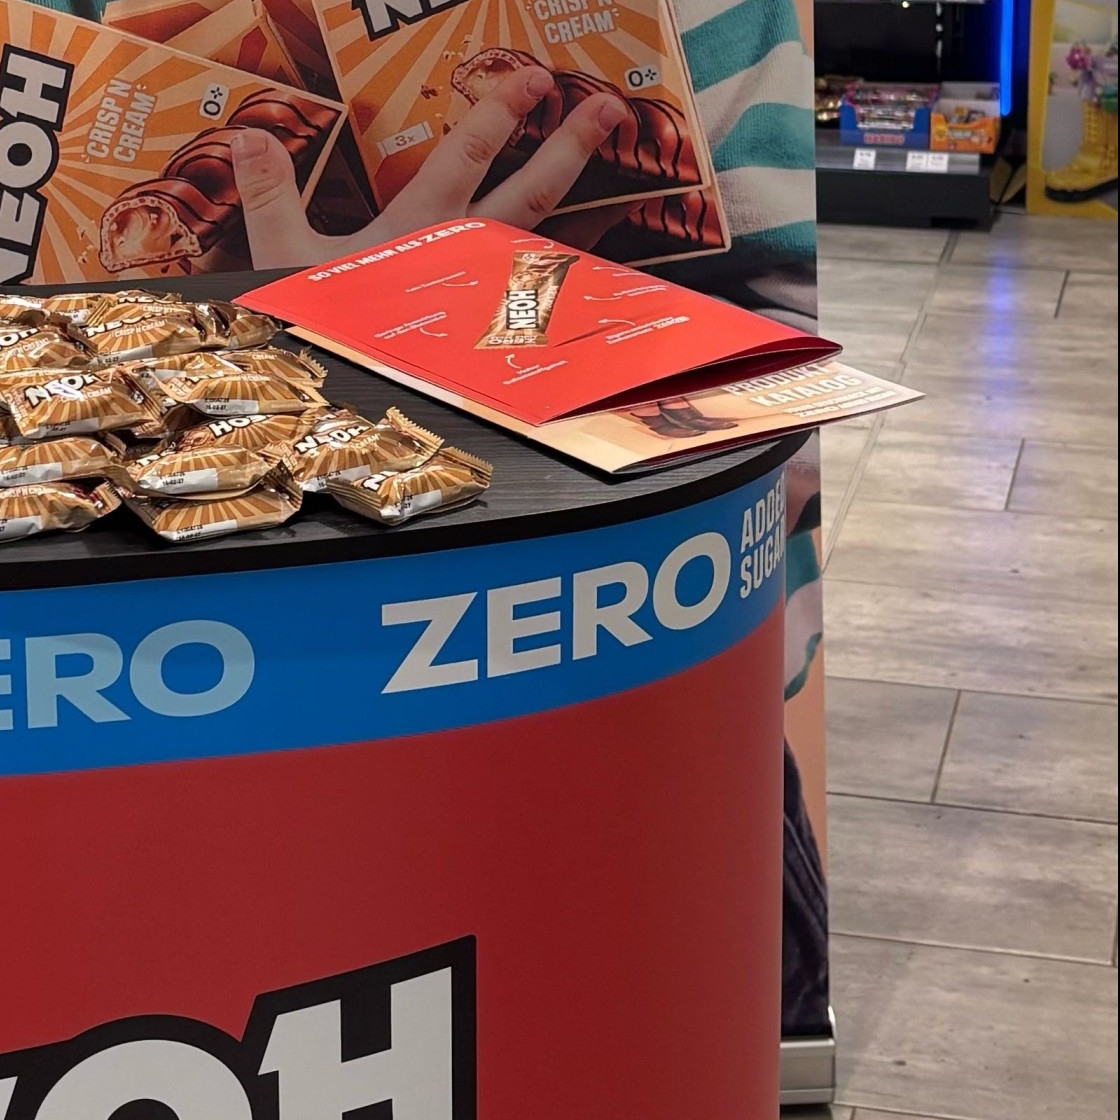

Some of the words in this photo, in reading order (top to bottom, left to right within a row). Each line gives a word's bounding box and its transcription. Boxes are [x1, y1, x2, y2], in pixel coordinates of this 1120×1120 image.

[543, 11, 615, 45] CREAM
[87, 99, 124, 160] CRISP
[112, 91, 156, 164] CREAM
[420, 222, 487, 244] ZERO
[508, 289, 537, 329] NEOH
[721, 362, 830, 396] PRODUKT
[749, 374, 863, 407] KATALOG
[380, 531, 731, 695] ZERO
